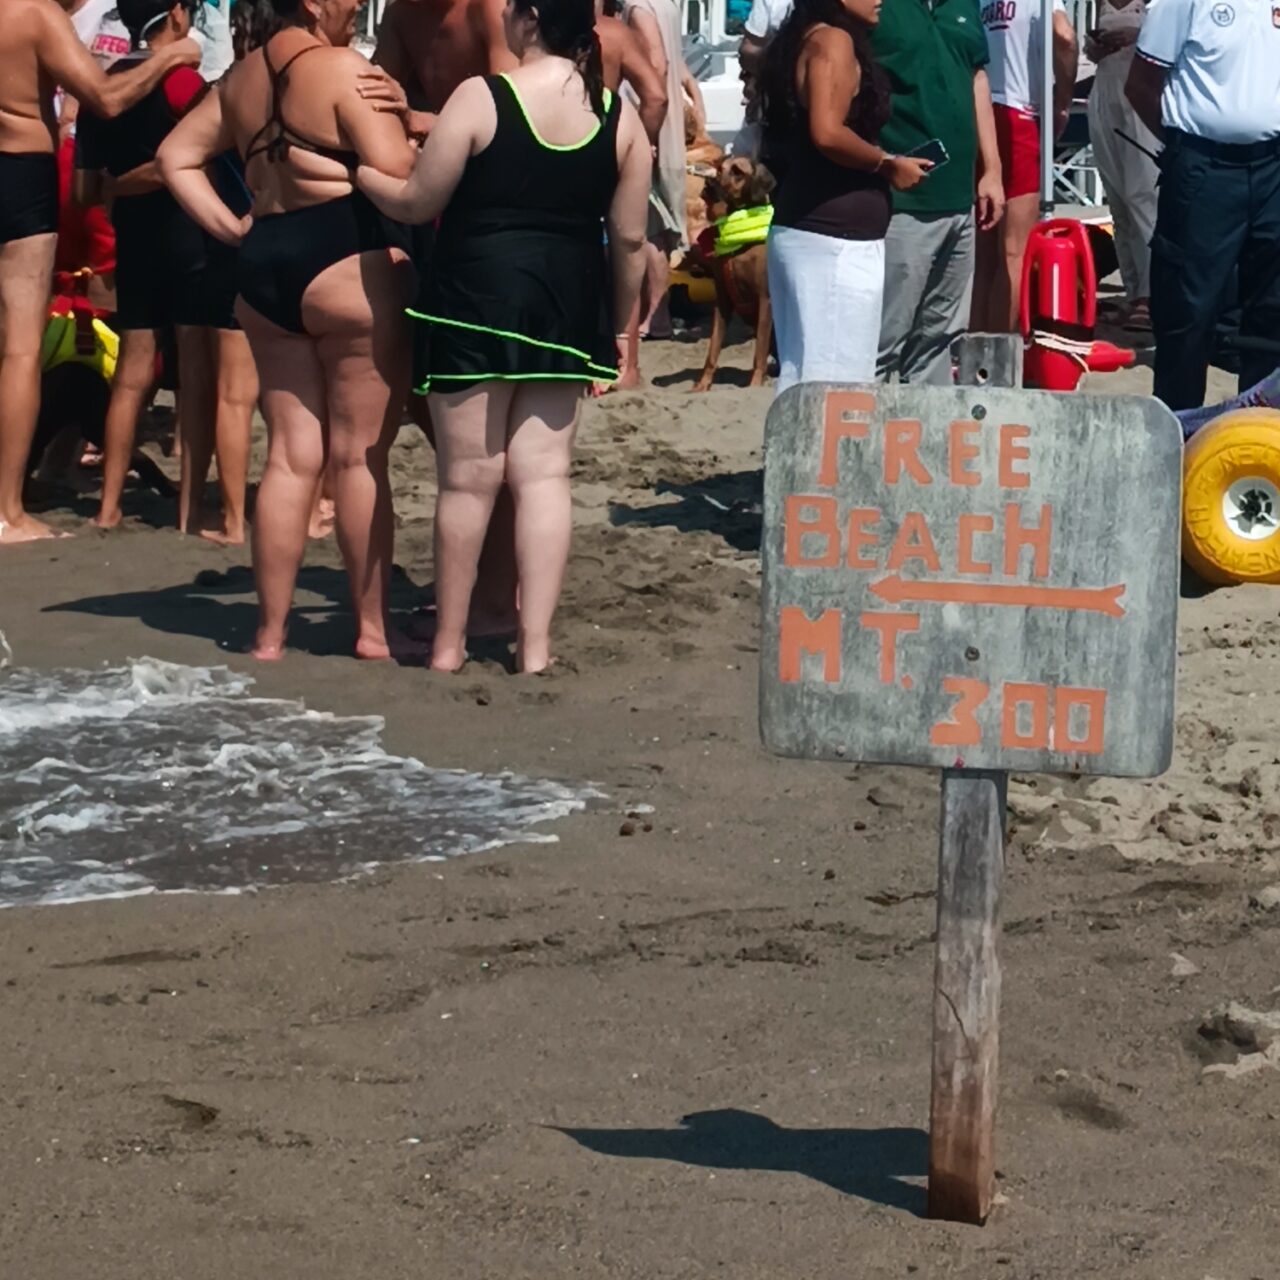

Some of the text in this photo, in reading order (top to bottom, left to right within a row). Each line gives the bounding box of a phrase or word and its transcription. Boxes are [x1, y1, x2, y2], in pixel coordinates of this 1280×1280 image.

[817, 389, 1031, 489] FREE
[783, 495, 1053, 578] BEACH
[778, 605, 920, 690] MT.
[929, 675, 1107, 755] 300
